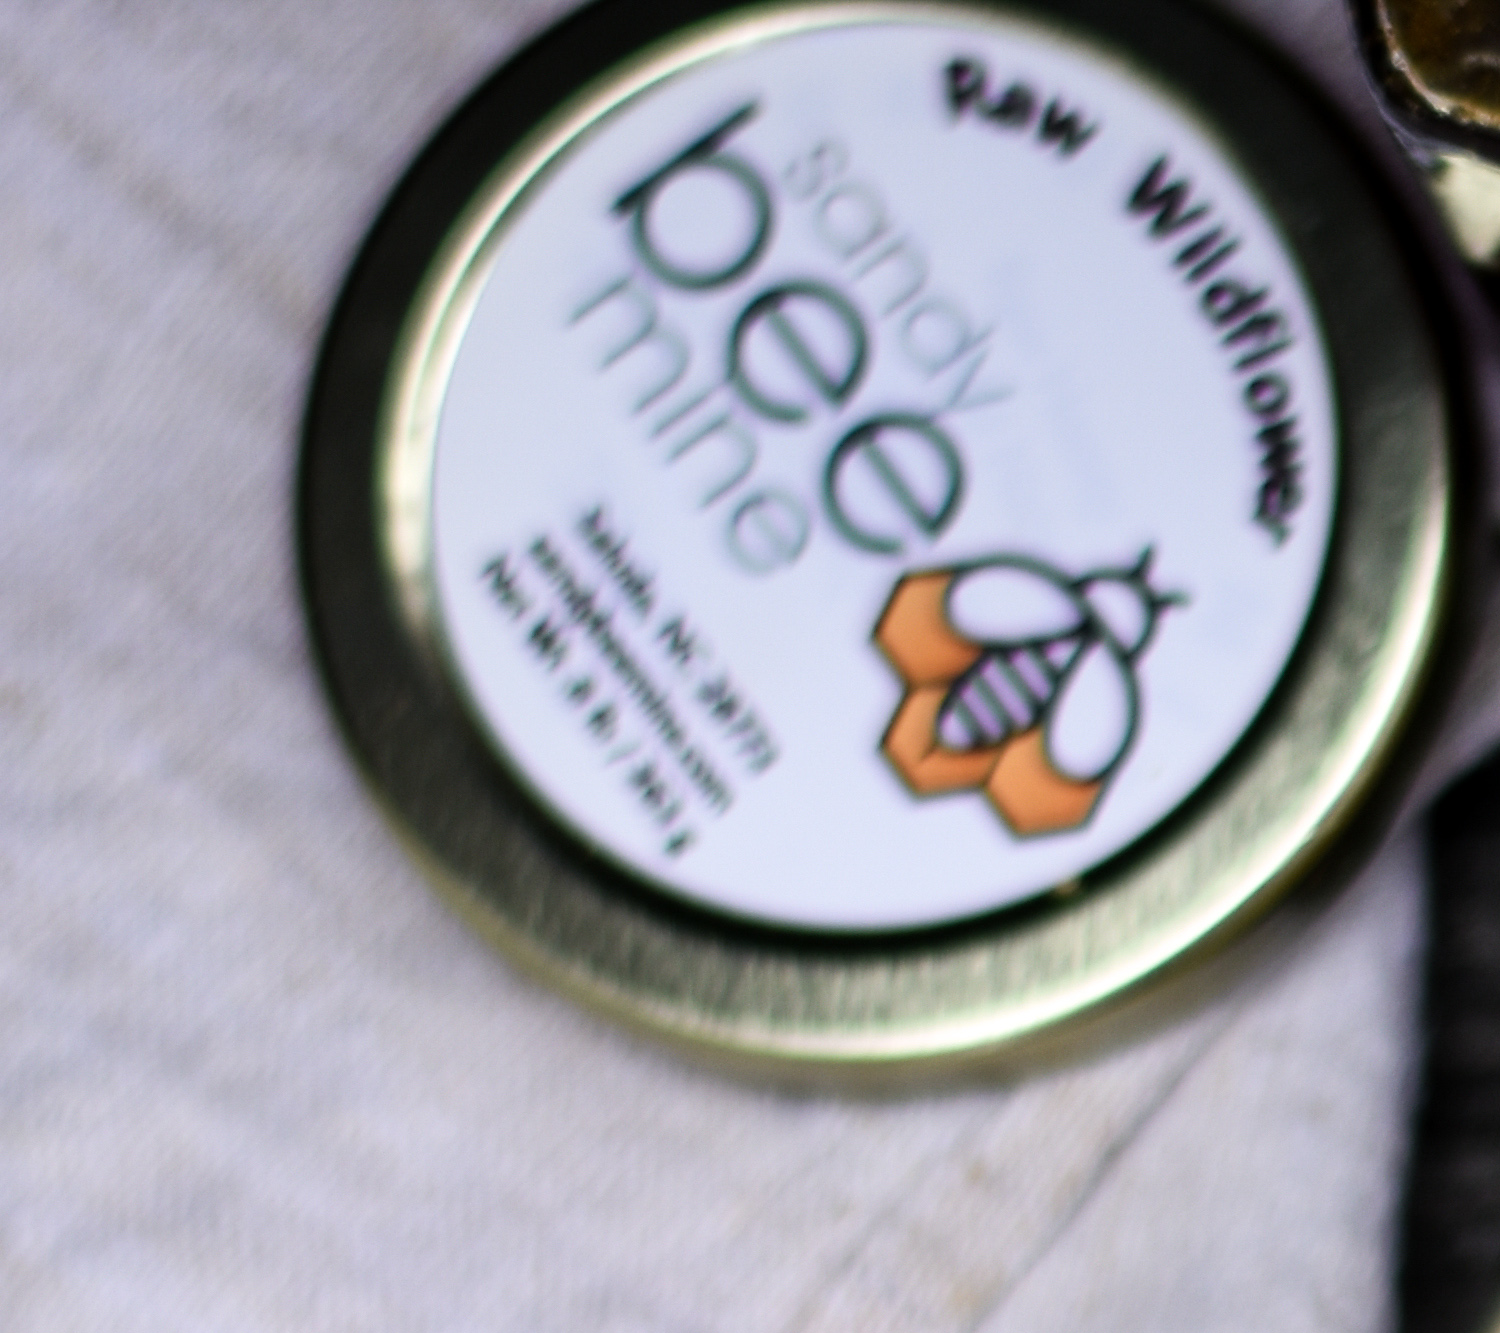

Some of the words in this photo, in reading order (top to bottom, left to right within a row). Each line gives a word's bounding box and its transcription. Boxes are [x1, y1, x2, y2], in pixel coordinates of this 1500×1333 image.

[565, 274, 814, 573] mine
[612, 99, 966, 556] bee
[778, 136, 1014, 418] sandy
[946, 55, 1101, 161] Raw
[1122, 152, 1304, 549] Wildflower
